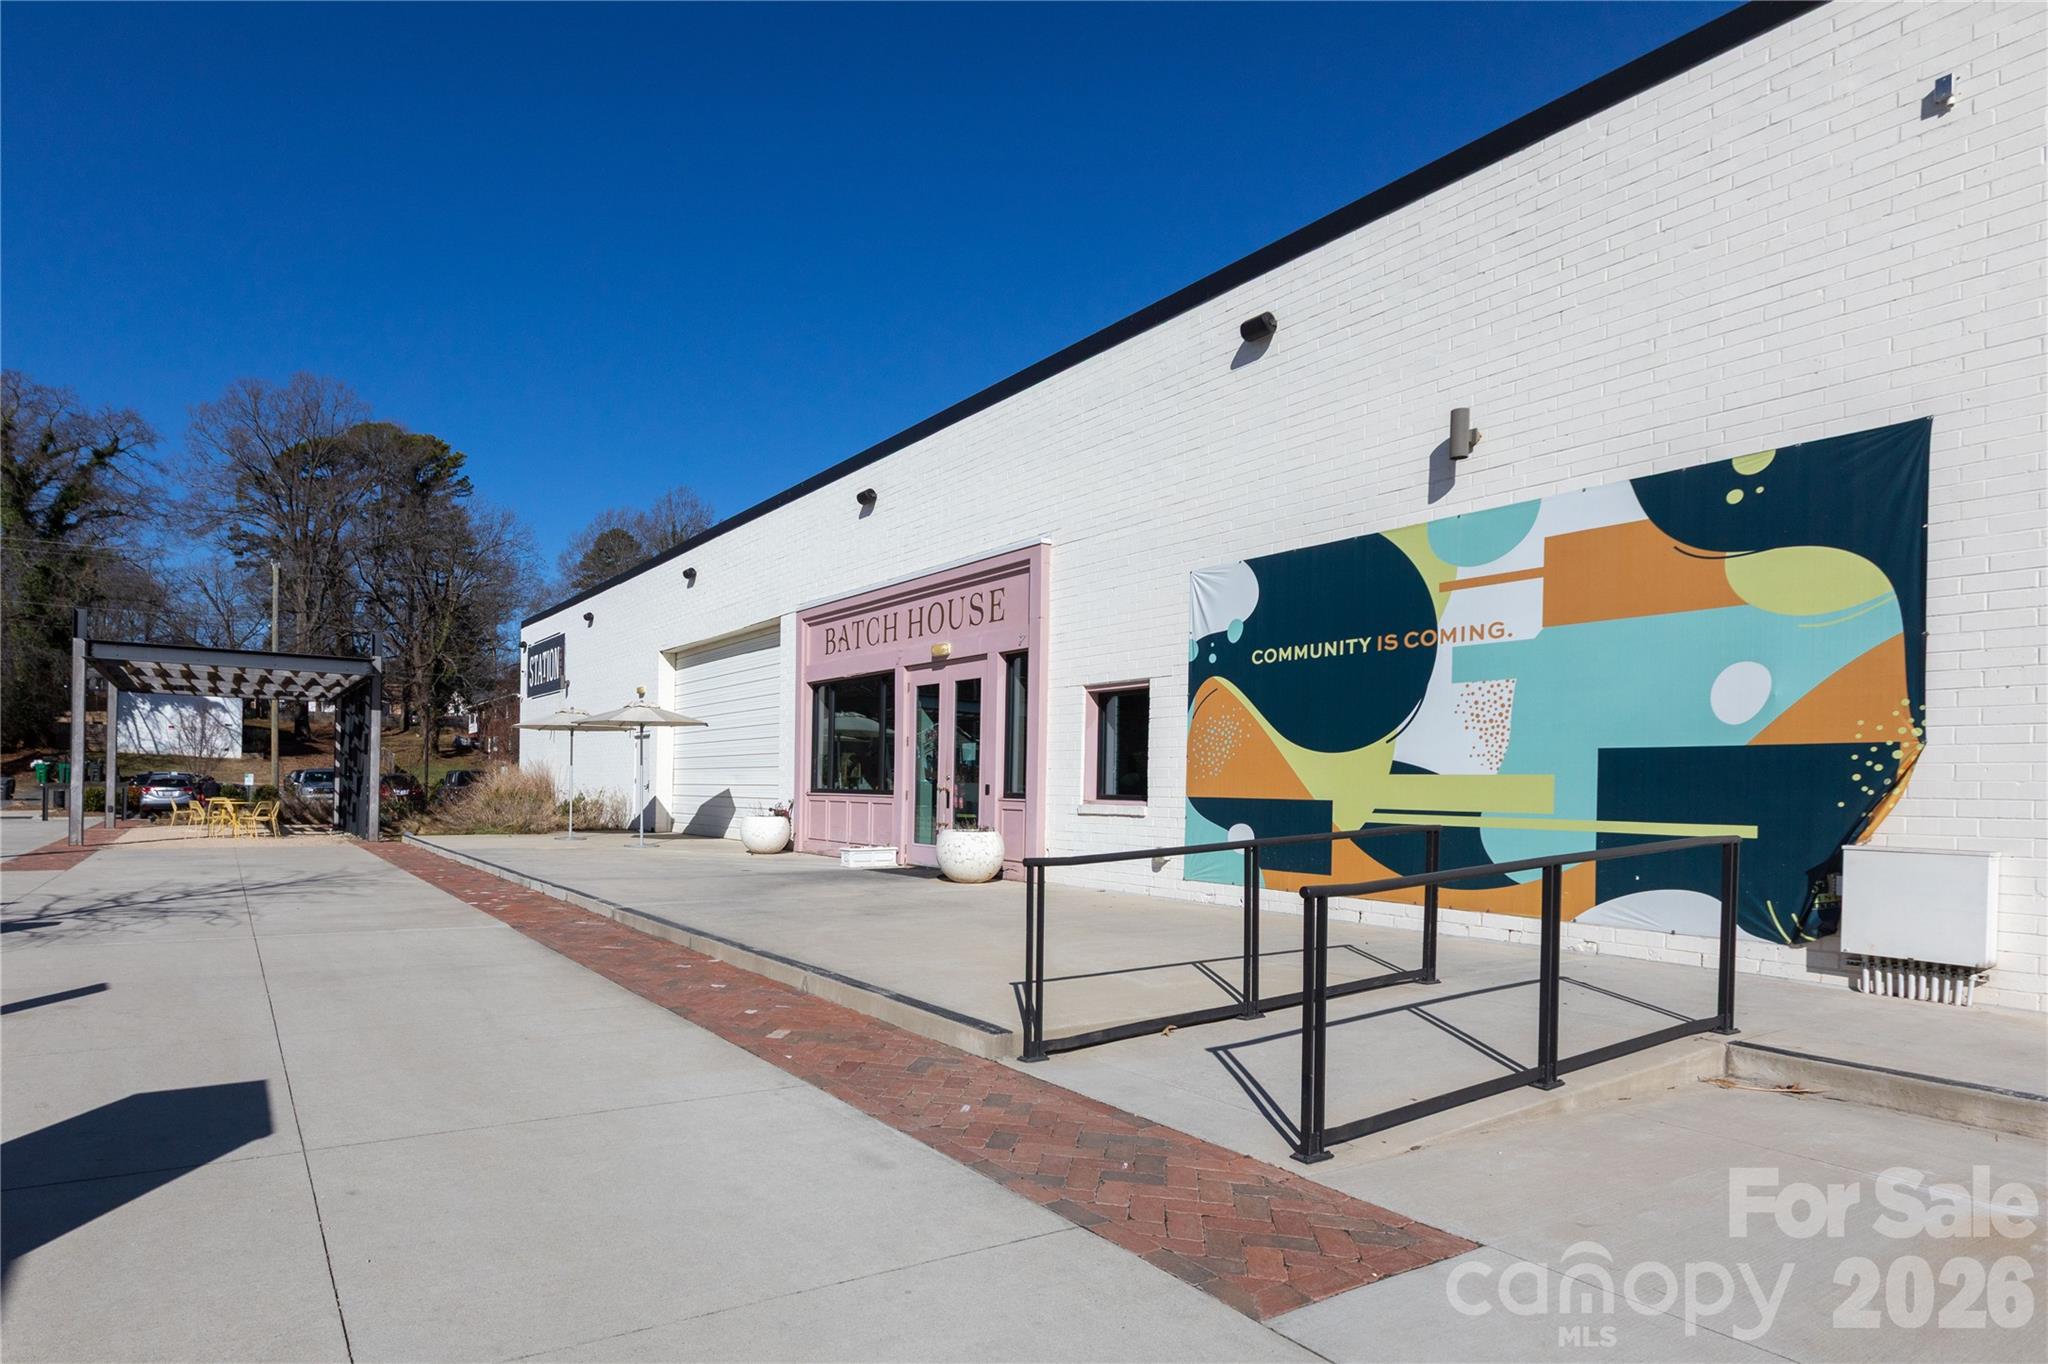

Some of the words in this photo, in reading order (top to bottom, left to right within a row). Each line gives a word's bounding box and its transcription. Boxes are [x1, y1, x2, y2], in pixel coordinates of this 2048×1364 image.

[825, 611, 898, 656] BATCH
[907, 587, 1005, 639] HOUSE
[1251, 636, 1372, 665] COMMUNITY
[1377, 633, 1399, 651] IS
[1403, 621, 1513, 648] COMING.
[529, 646, 561, 688] STATION
